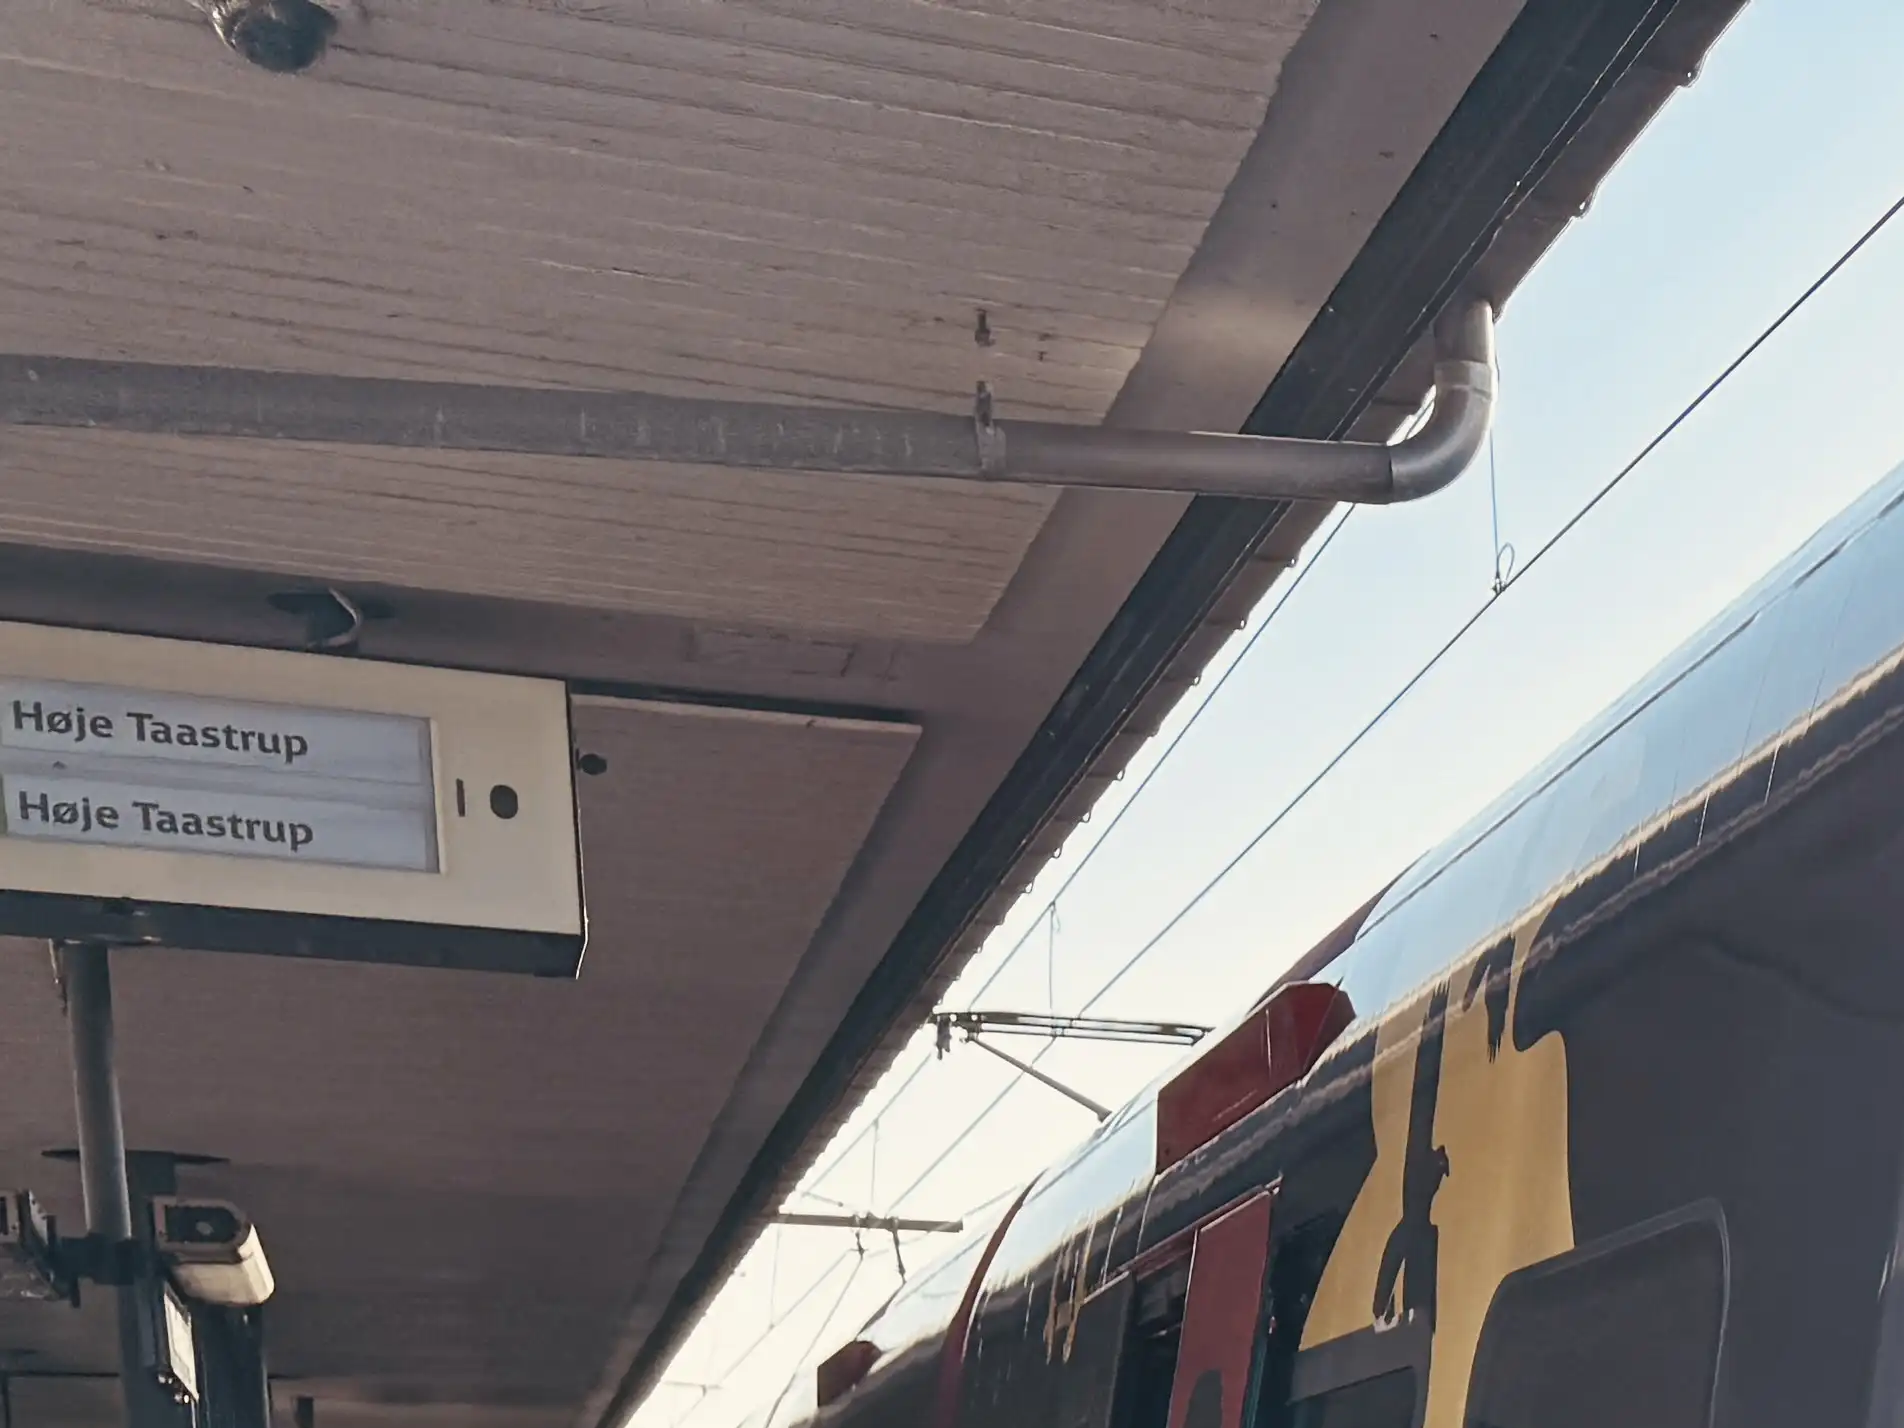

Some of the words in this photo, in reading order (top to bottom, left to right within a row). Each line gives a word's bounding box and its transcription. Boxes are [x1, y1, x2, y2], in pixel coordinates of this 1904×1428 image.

[12, 699, 114, 743] Høje
[126, 711, 309, 765] Taastrup
[18, 790, 120, 833] Høje
[131, 800, 315, 853] Taastrup
